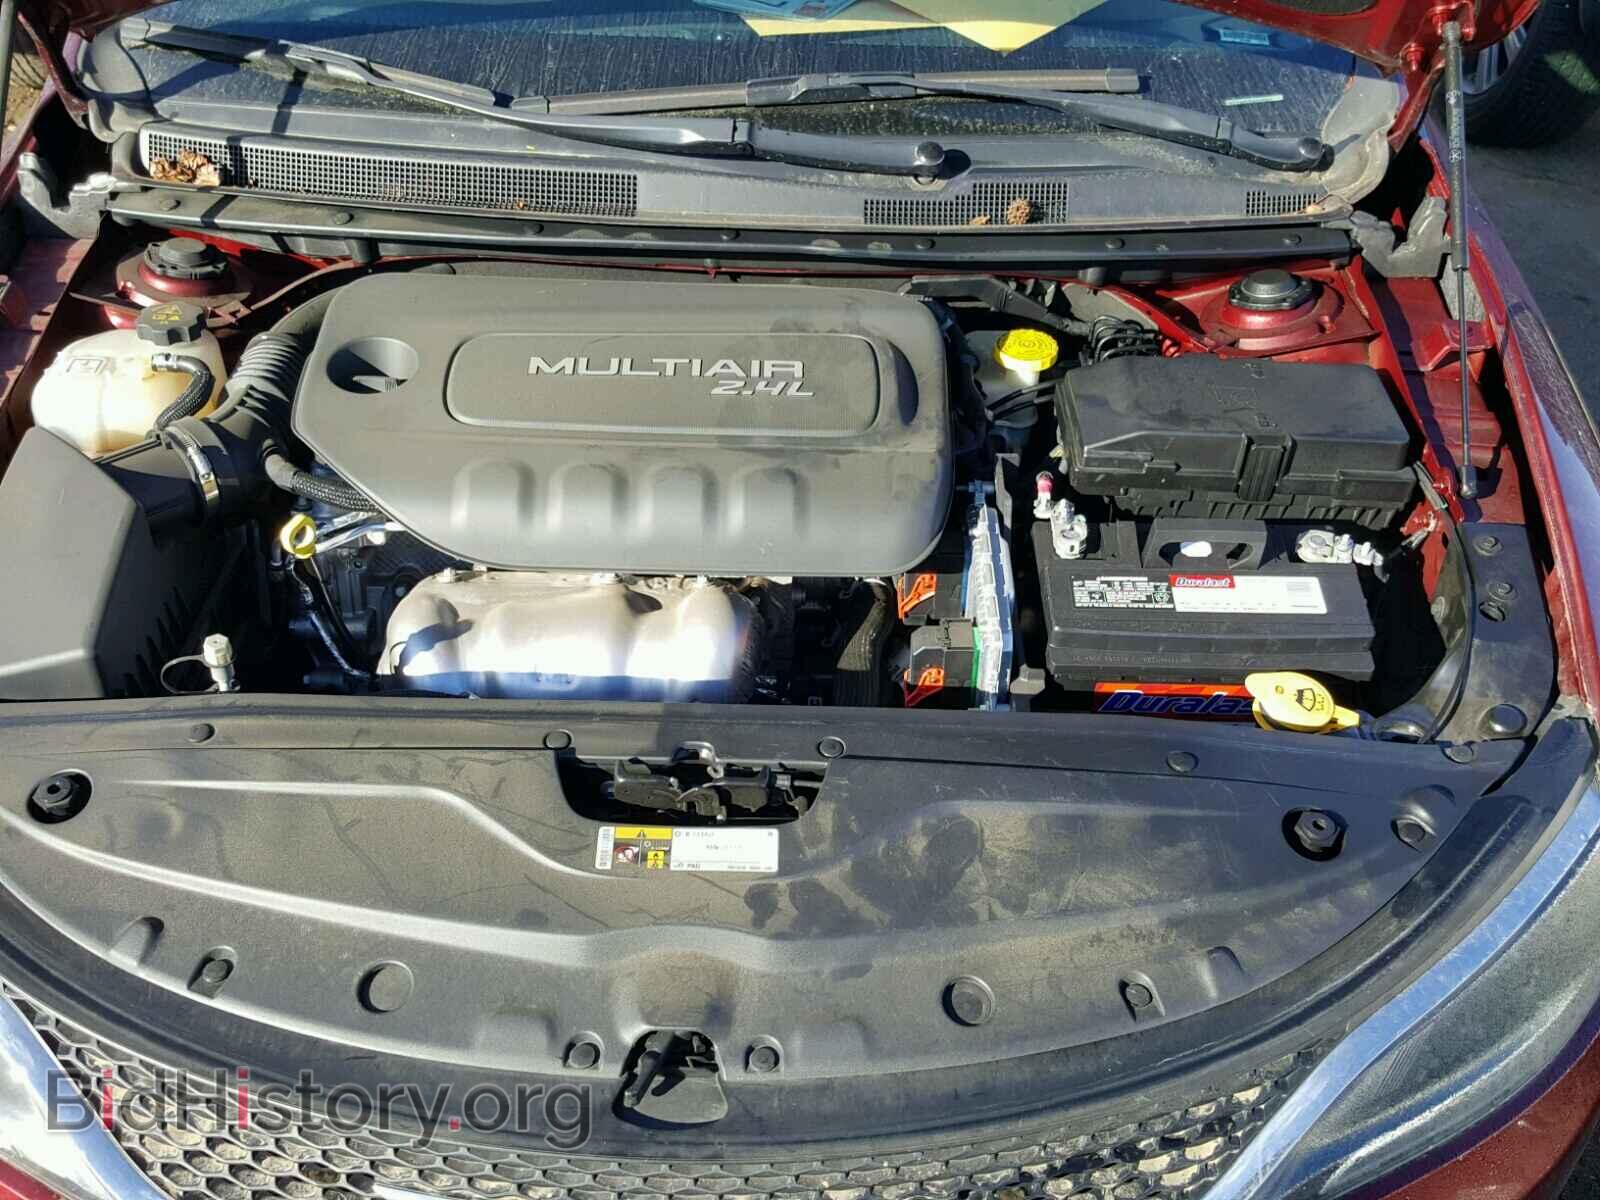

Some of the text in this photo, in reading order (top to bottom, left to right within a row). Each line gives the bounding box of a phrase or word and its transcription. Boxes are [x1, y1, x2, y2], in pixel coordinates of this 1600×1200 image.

[528, 356, 804, 377] MULTIAIR
[710, 380, 814, 396] 2.4L
[1175, 577, 1231, 588] Duralast
[1099, 690, 1253, 714] Durala
